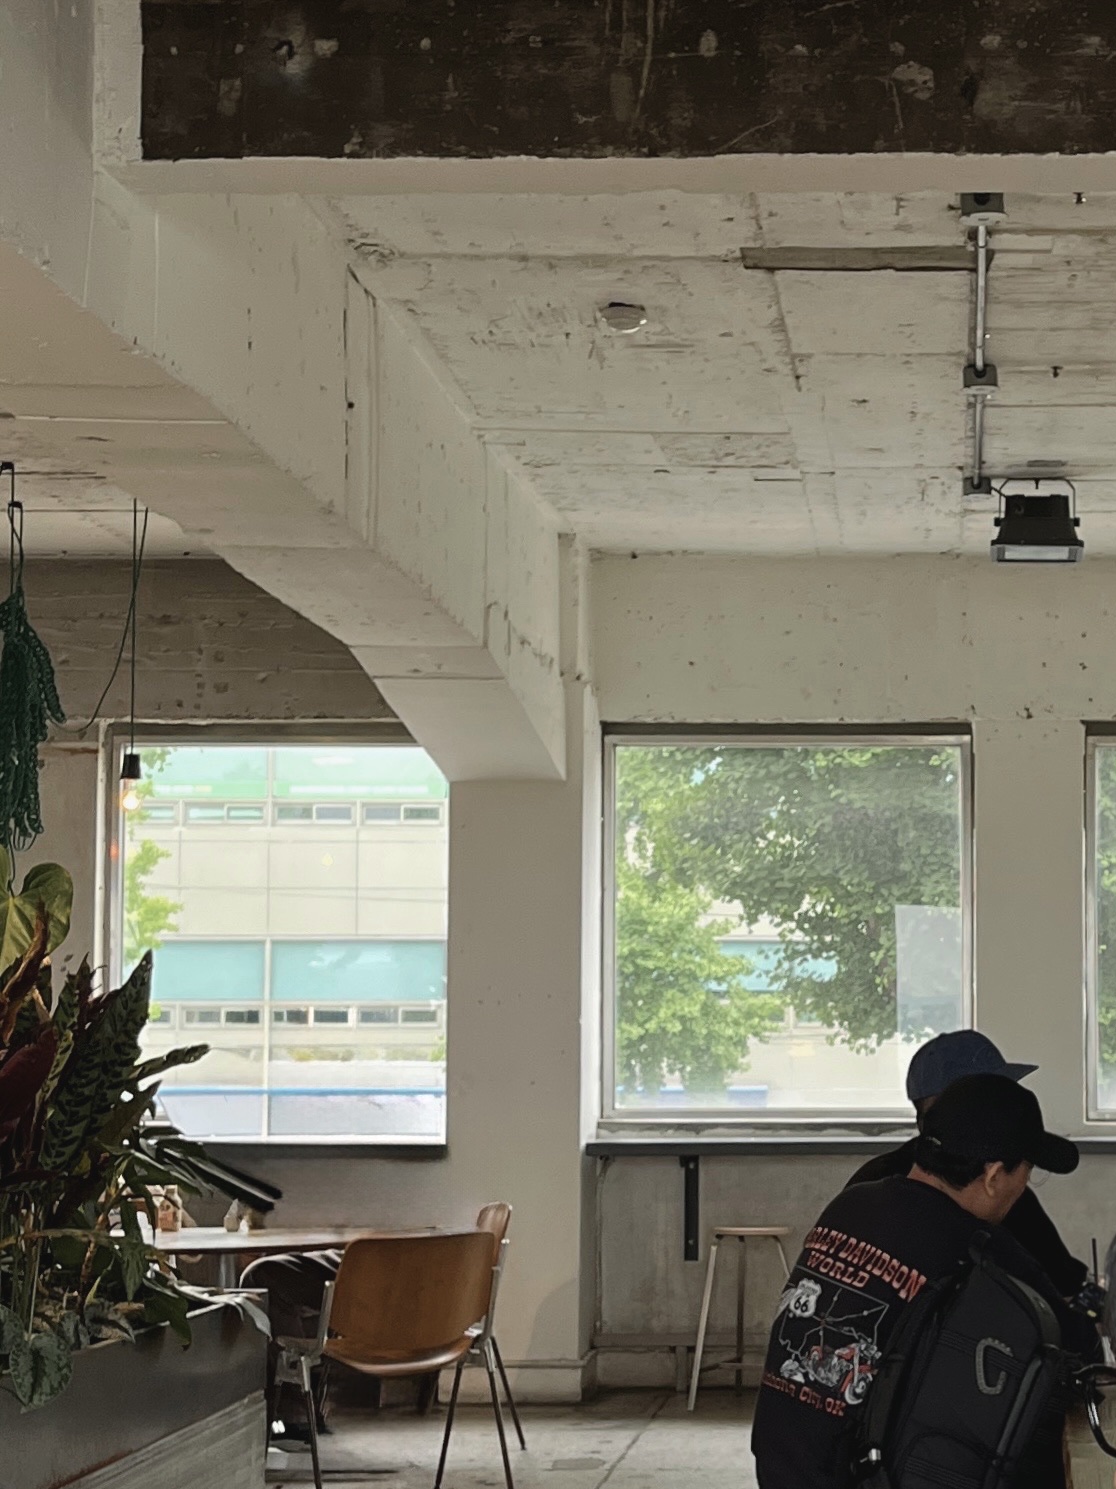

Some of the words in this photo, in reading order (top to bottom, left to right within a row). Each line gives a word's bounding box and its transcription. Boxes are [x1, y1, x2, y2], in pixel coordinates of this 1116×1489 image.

[806, 1251, 870, 1288] WORLD
[838, 1237, 927, 1303] DAVIDSON
[793, 1295, 810, 1313] 66
